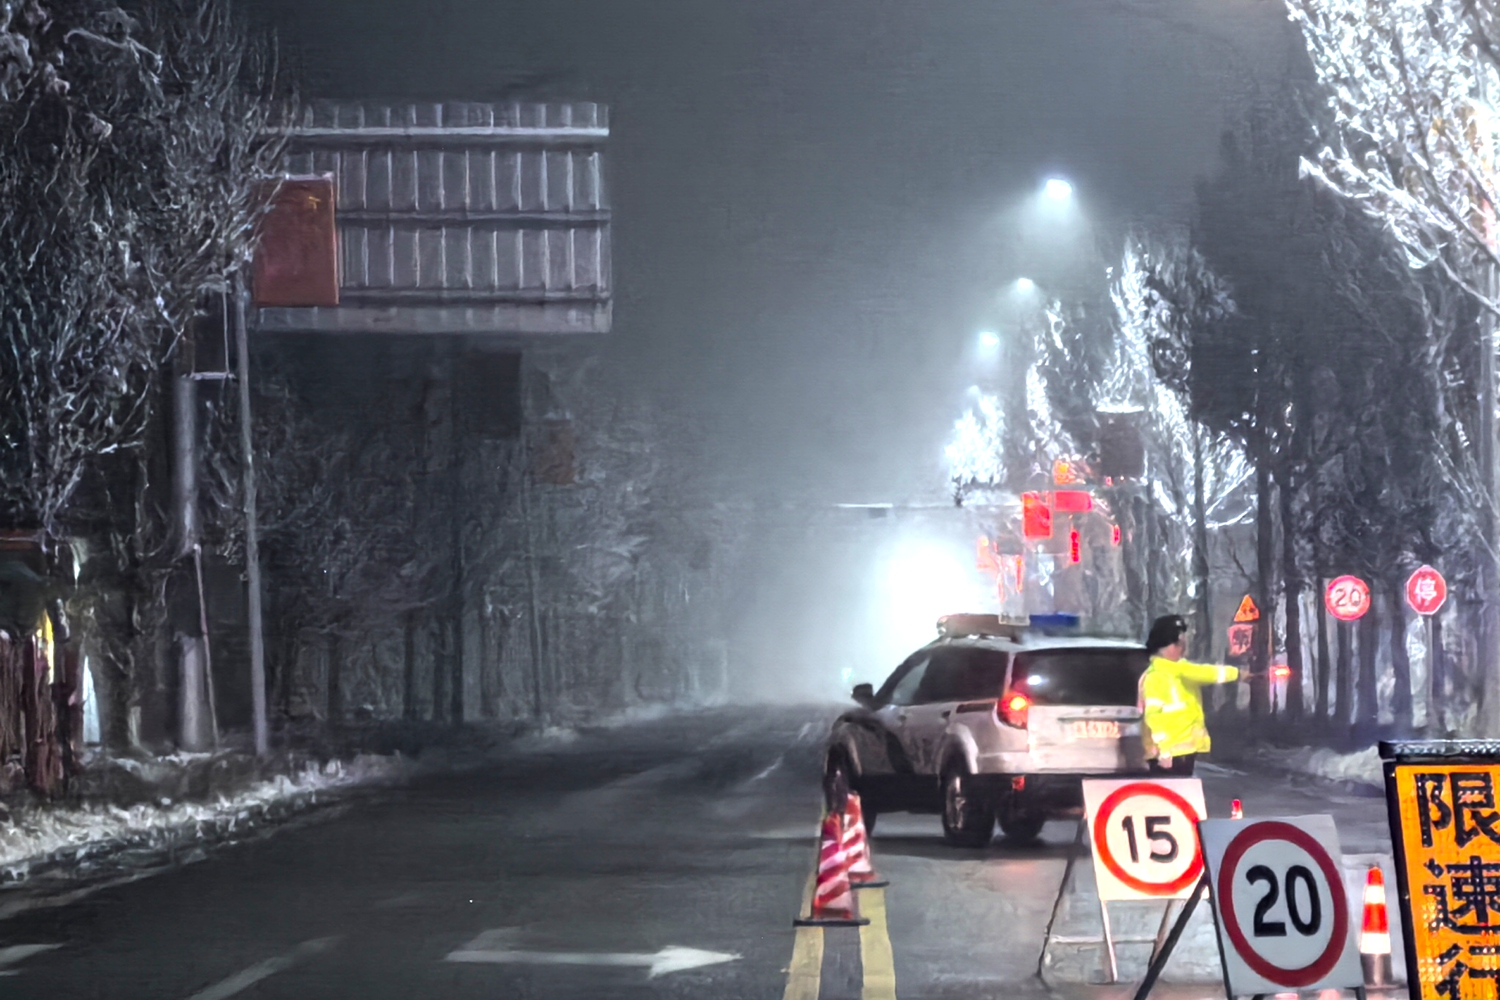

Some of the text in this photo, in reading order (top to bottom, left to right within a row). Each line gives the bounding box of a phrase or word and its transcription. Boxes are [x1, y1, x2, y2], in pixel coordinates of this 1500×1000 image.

[1334, 587, 1361, 607] 20
[1413, 575, 1437, 606] 停
[1121, 815, 1179, 864] 15
[1246, 864, 1322, 938] 20
